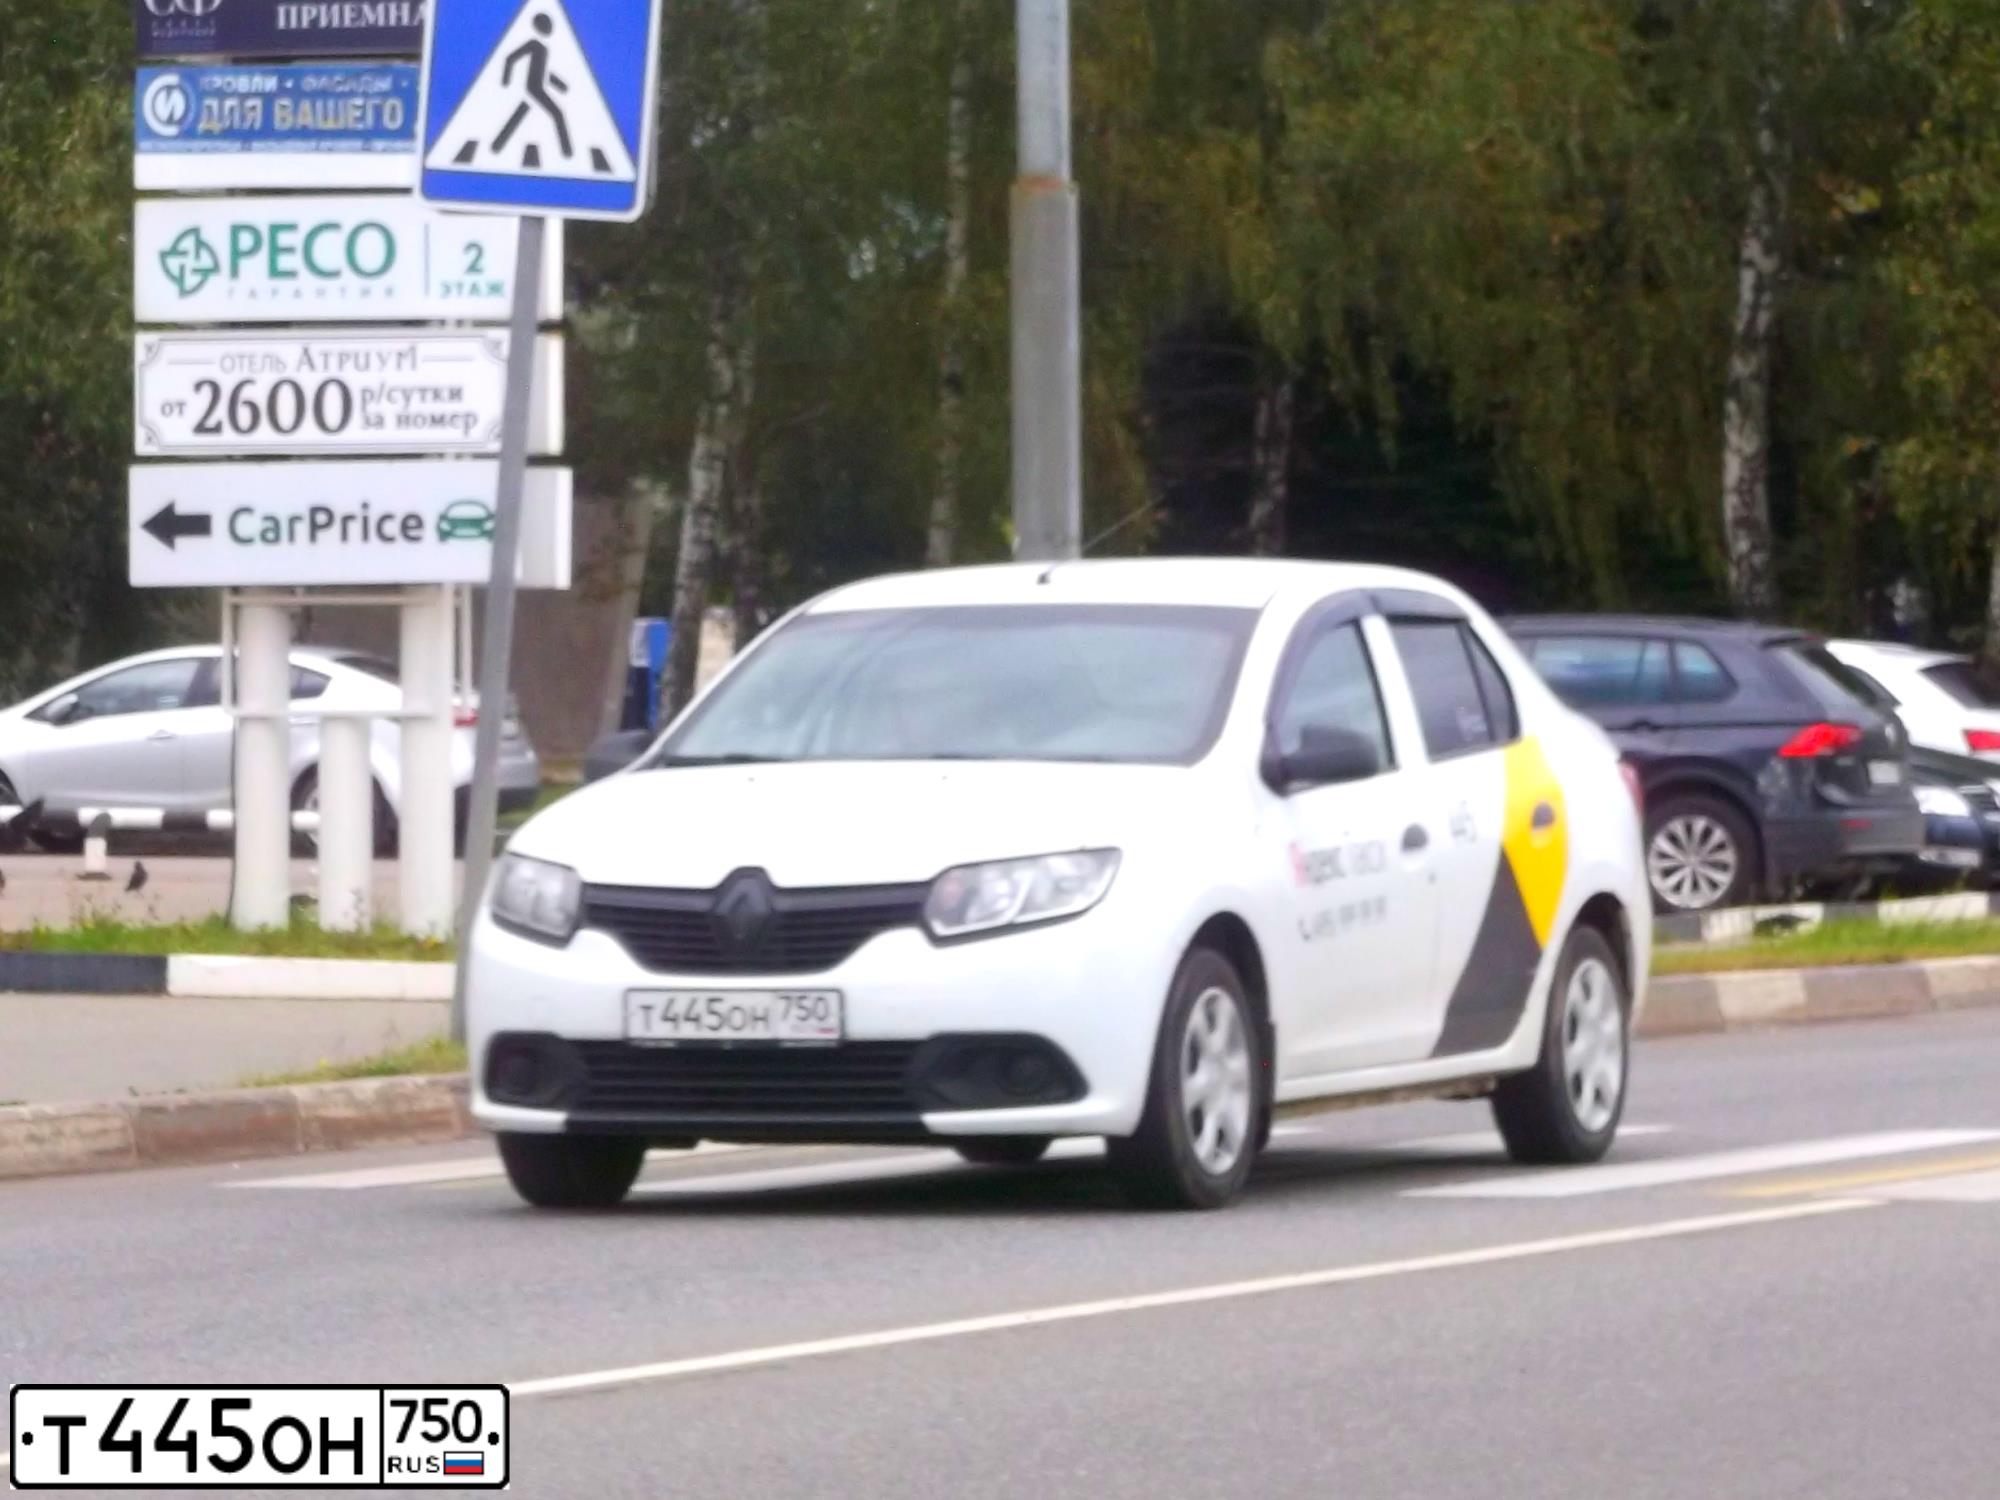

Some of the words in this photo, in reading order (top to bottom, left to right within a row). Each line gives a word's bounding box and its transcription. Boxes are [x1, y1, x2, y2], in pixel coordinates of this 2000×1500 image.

[199, 99, 263, 134] ДЛЯ
[274, 98, 404, 131] ВАШЕГО
[229, 222, 397, 279] РЕСО
[463, 242, 485, 275] 2
[441, 281, 504, 299] ЭТАЖ
[160, 401, 186, 418] от
[192, 378, 353, 436] 2600
[360, 384, 463, 412] р/сутки
[397, 411, 478, 437] номер
[228, 501, 424, 544] CarPrice
[641, 997, 769, 1032] Т445ОН
[778, 995, 829, 1022] 750
